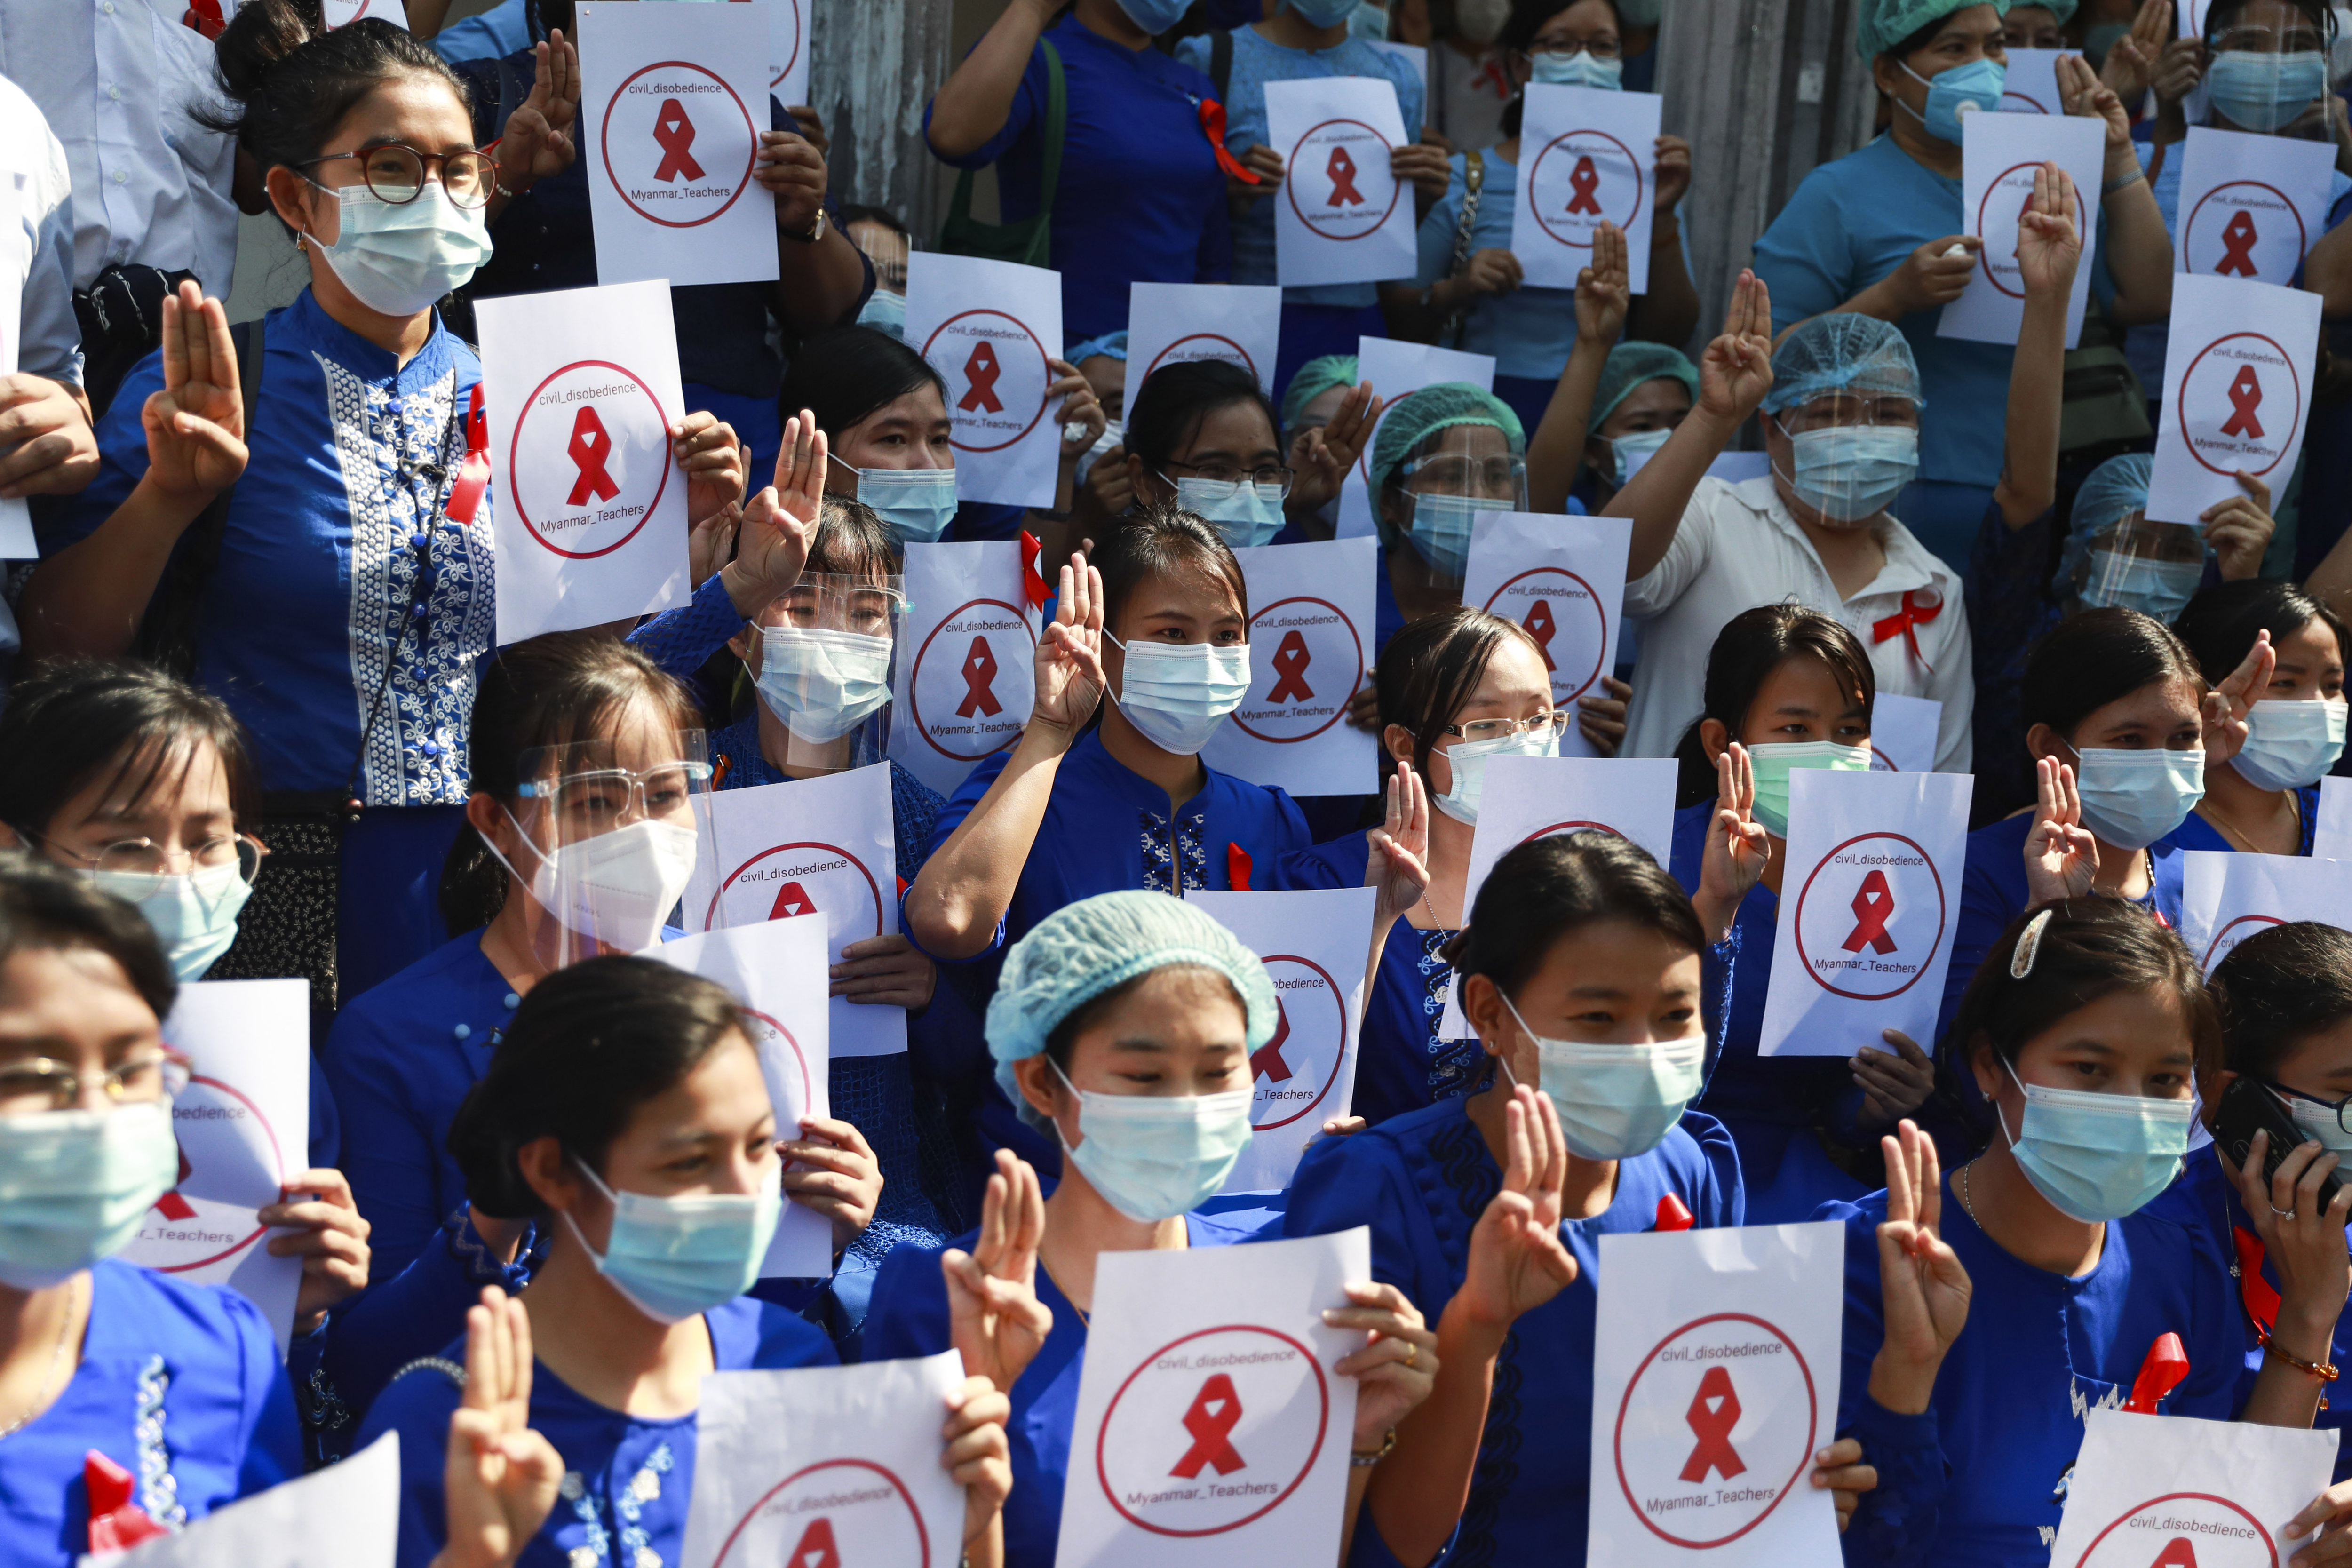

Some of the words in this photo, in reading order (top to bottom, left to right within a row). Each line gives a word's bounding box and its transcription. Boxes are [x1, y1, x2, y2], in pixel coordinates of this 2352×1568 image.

[629, 84, 722, 95] civil_disobedience
[631, 187, 730, 201] Myanmar_Teachers
[539, 383, 636, 406] civil_disobedience
[540, 504, 644, 533] Myanmar_Teachers
[1508, 587, 1588, 599] civil_disobedience
[946, 621, 1022, 633] civil_disobedience
[1255, 616, 1338, 629] civil_disobedience
[1241, 707, 1334, 721] Myanmar_Teachers
[931, 723, 1021, 736] Myanmar_Teachers
[1835, 854, 1923, 868] civil_disobedience
[740, 859, 847, 883] civil_disobedience
[1814, 958, 1917, 974] Myanmar_Teachers
[1253, 1089, 1313, 1101] r_Teachers
[1661, 1341, 1781, 1361] civil_disobedience
[1157, 1349, 1295, 1371] civil_disobedience
[1128, 1481, 1278, 1506] Myanmar_Teachers
[1646, 1487, 1774, 1513] Myanmar_Teachers
[2130, 1516, 2255, 1539] civil_disobedience
